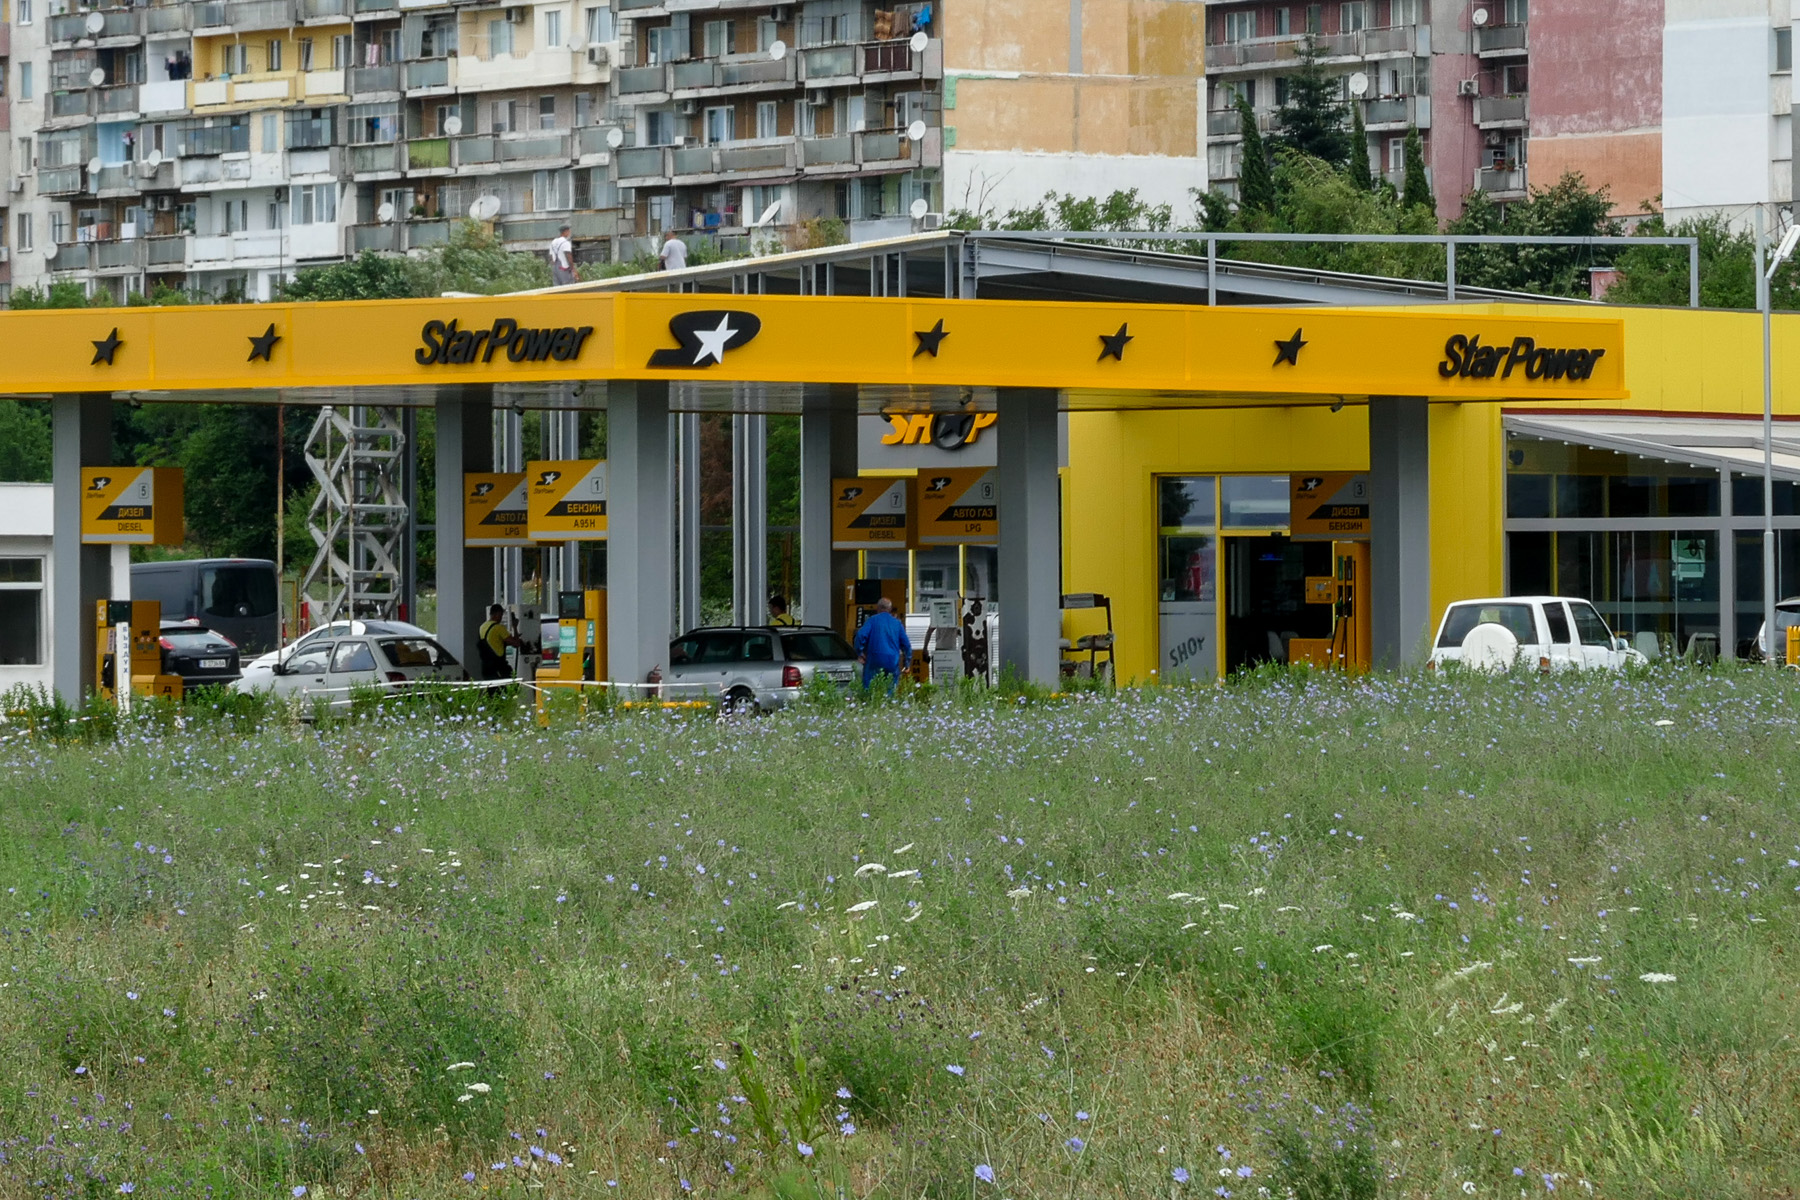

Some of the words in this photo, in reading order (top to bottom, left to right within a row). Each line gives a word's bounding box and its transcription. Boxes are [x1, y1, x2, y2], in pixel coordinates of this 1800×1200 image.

[415, 317, 594, 366] StarPower
[1438, 333, 1606, 381] StarPower
[141, 485, 147, 497] 5
[595, 480, 599, 491] 1
[985, 485, 991, 497] 9
[894, 494, 899, 505] 7
[567, 503, 602, 513] БЕНЗИН
[952, 508, 976, 519] АВТО
[977, 508, 994, 519] ГАЗ
[117, 522, 143, 532] DIESEL
[504, 527, 520, 536] LPG
[964, 523, 982, 533] LPG
[1328, 521, 1363, 531] БЕНЗИН
[869, 530, 896, 539] DIESEL
